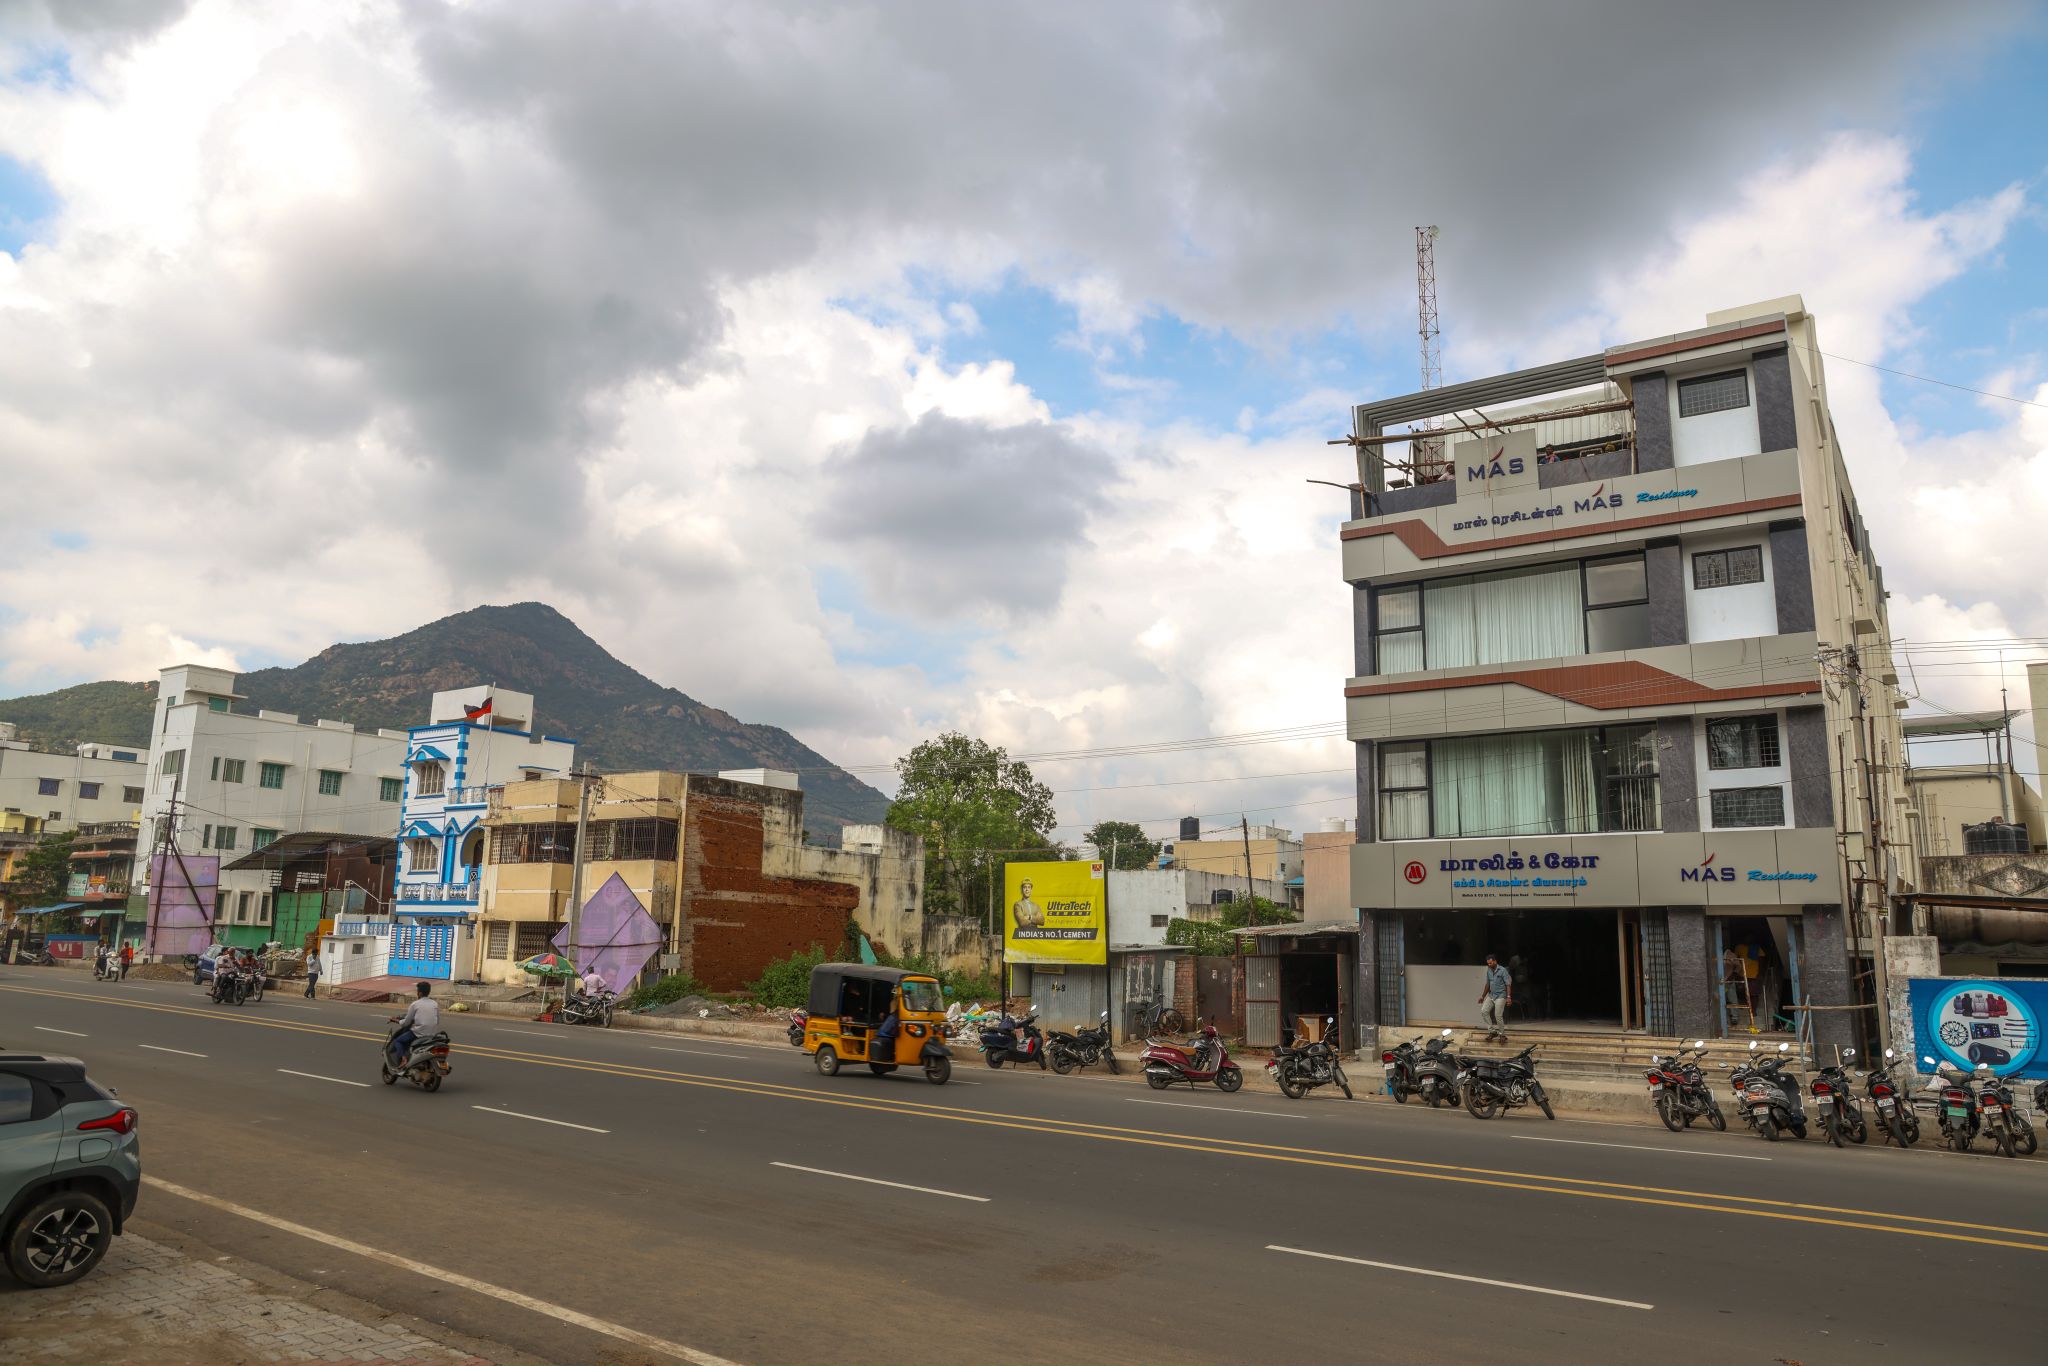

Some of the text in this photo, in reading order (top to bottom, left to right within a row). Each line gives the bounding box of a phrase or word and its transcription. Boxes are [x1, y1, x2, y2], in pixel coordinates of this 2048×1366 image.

[1467, 457, 1524, 482] MAS
[1453, 515, 1488, 531] மாஸ்
[1574, 493, 1623, 513] MAS
[1636, 488, 1698, 503] Residency
[1440, 850, 1600, 871] மாலிக் & கோ
[1681, 867, 1819, 883] MAS Residency
[1047, 901, 1092, 911] UltraTech
[1045, 930, 1062, 938] NO.1
